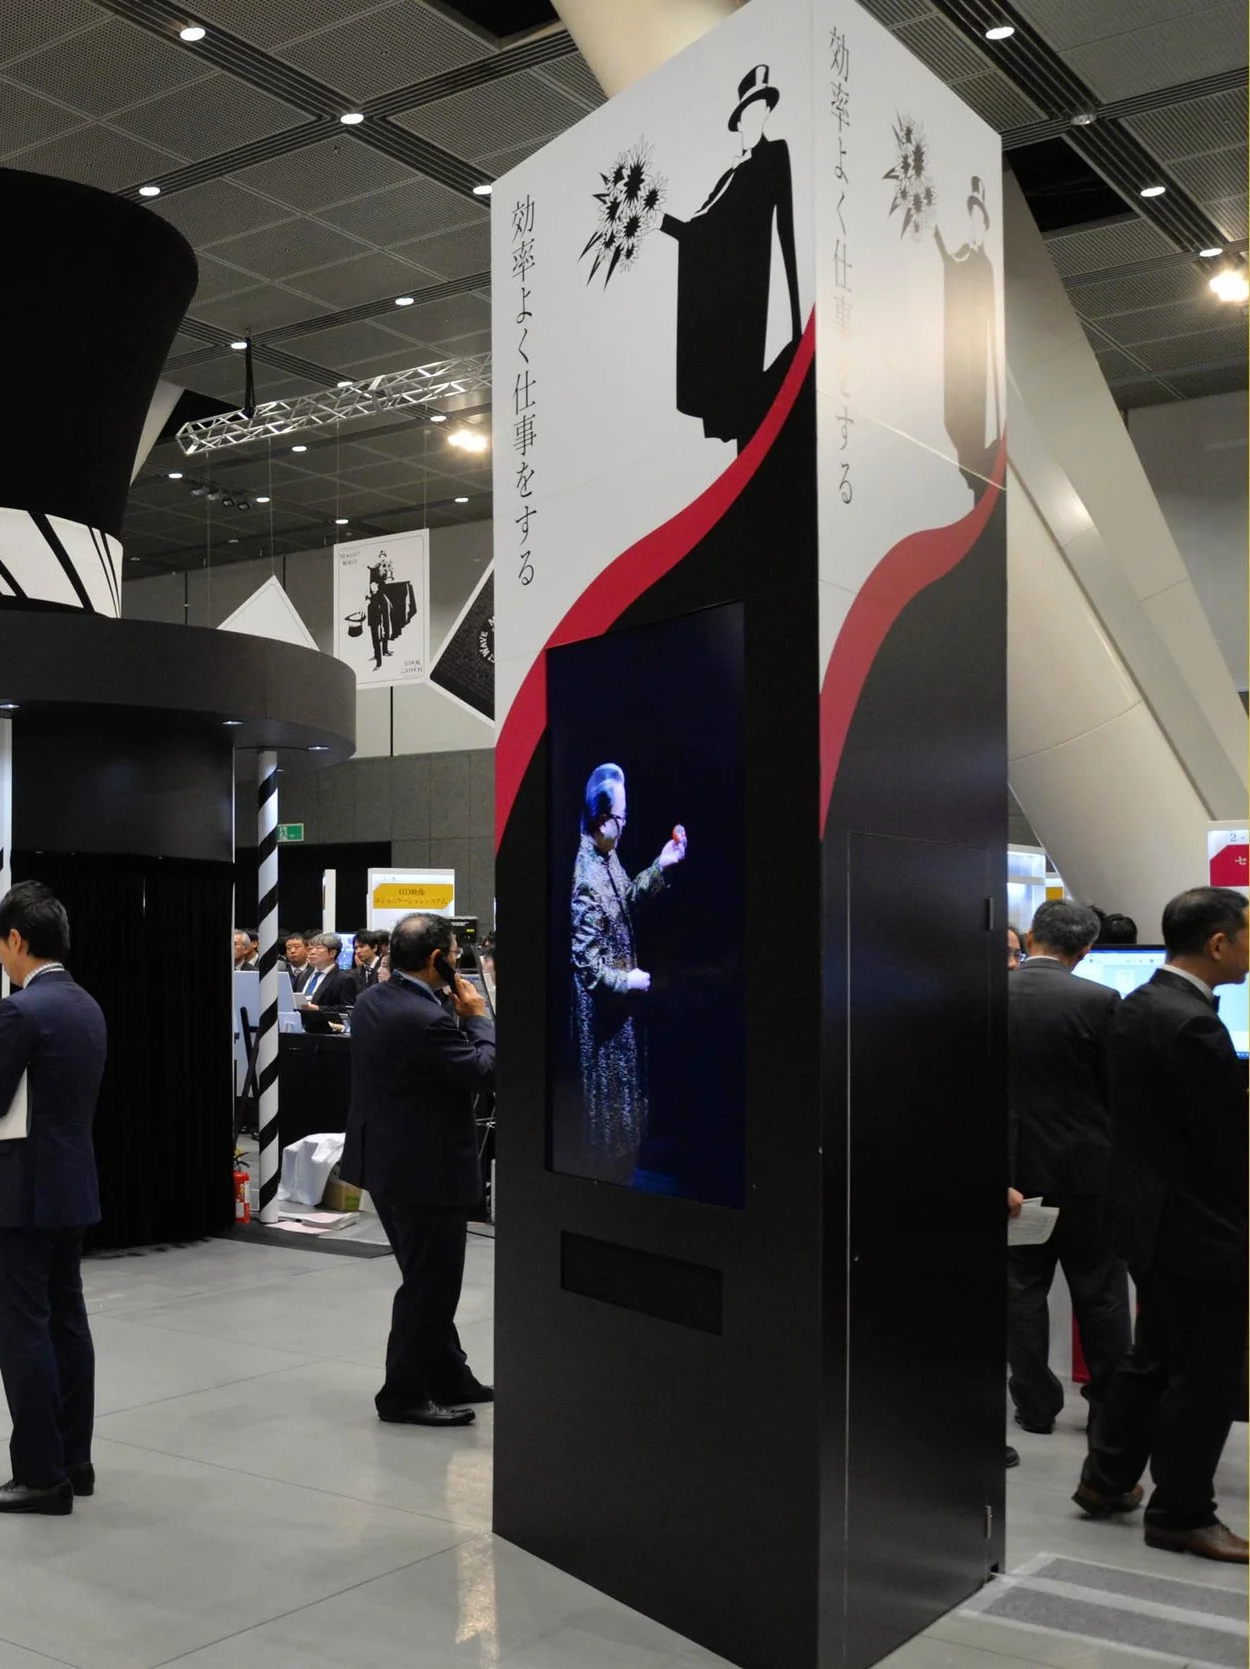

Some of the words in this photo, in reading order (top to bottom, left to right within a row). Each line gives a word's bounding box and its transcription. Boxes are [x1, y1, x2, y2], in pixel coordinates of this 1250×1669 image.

[511, 193, 538, 587] 効率よく仕事をする
